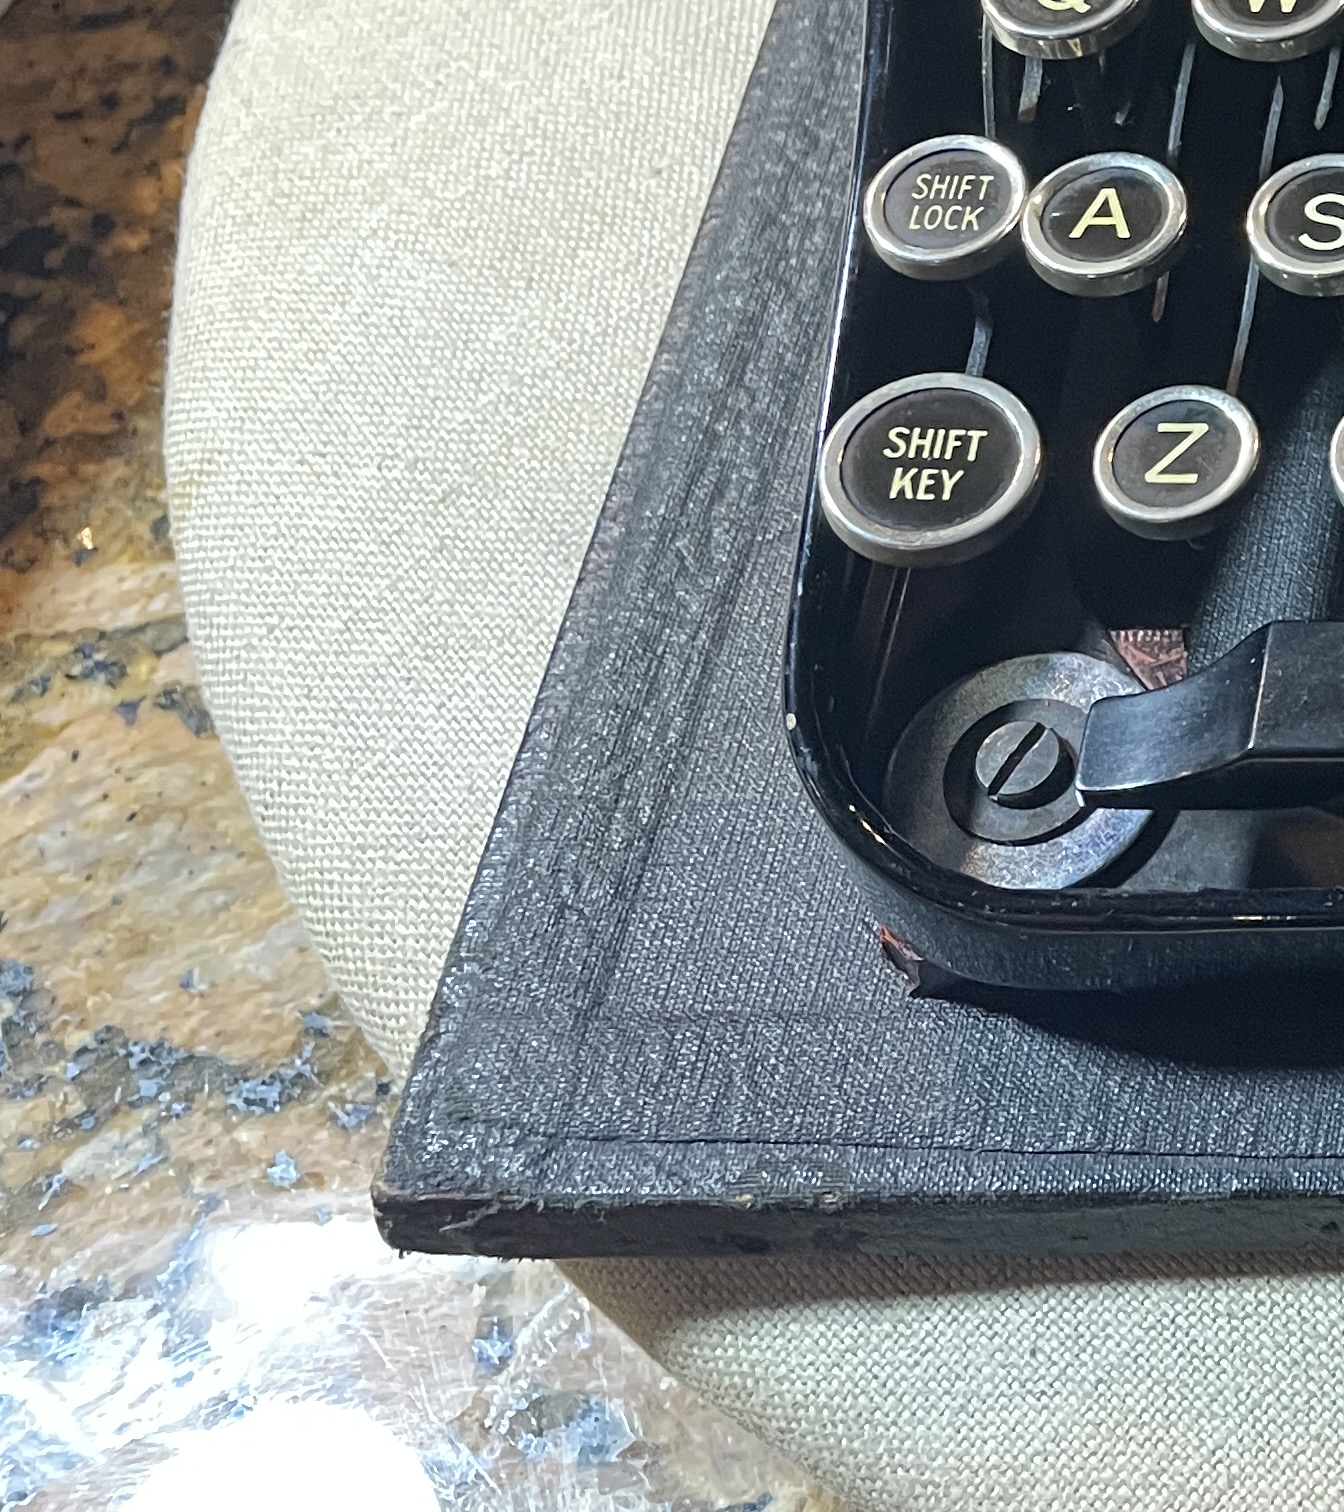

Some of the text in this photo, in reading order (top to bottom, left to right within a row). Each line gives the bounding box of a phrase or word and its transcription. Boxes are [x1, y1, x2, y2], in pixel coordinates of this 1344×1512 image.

[907, 168, 994, 200] SHIFT
[903, 205, 984, 235] LOCK
[1069, 188, 1130, 238] A
[883, 427, 988, 461] SHIFT
[1145, 423, 1209, 483] Z
[890, 467, 964, 500] KEY
